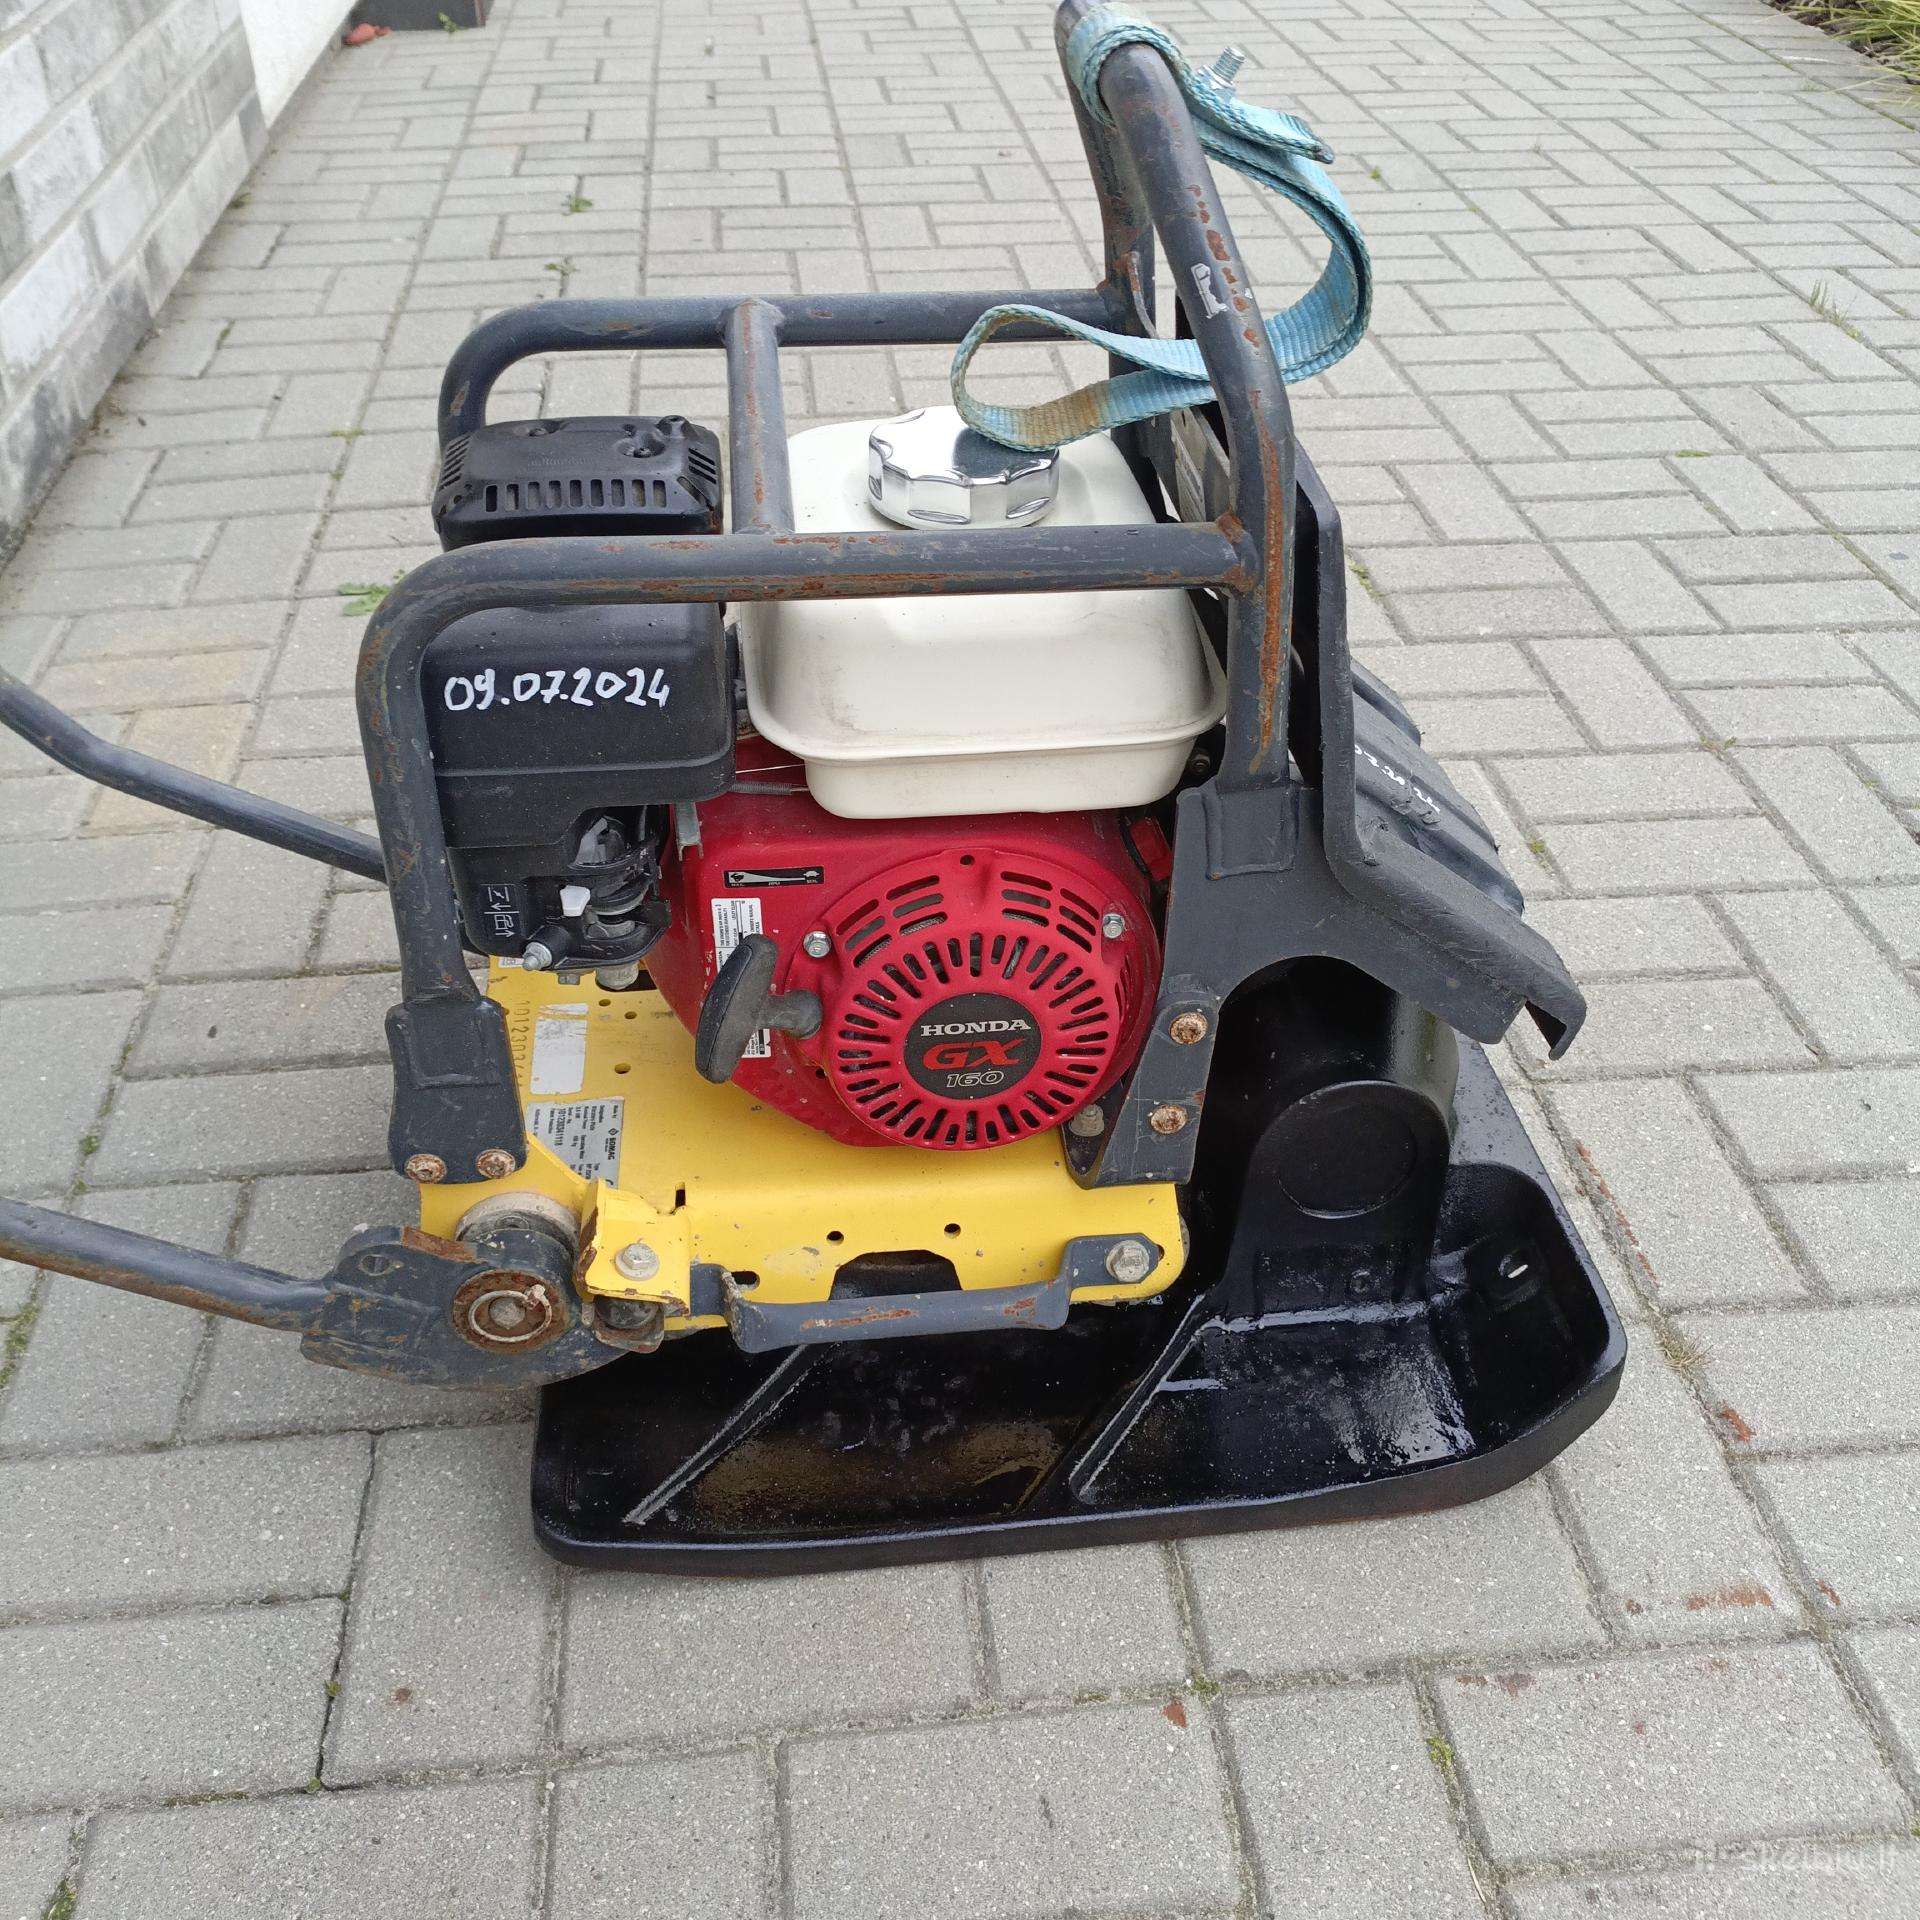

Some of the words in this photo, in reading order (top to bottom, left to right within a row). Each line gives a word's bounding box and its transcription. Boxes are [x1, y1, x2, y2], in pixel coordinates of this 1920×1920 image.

[444, 667, 670, 711] 09.07.2024
[920, 1019, 1032, 1037] HONDA
[922, 1036, 1027, 1071] GX
[946, 1070, 1005, 1088] 160
[608, 1138, 616, 1160] BOMAG
